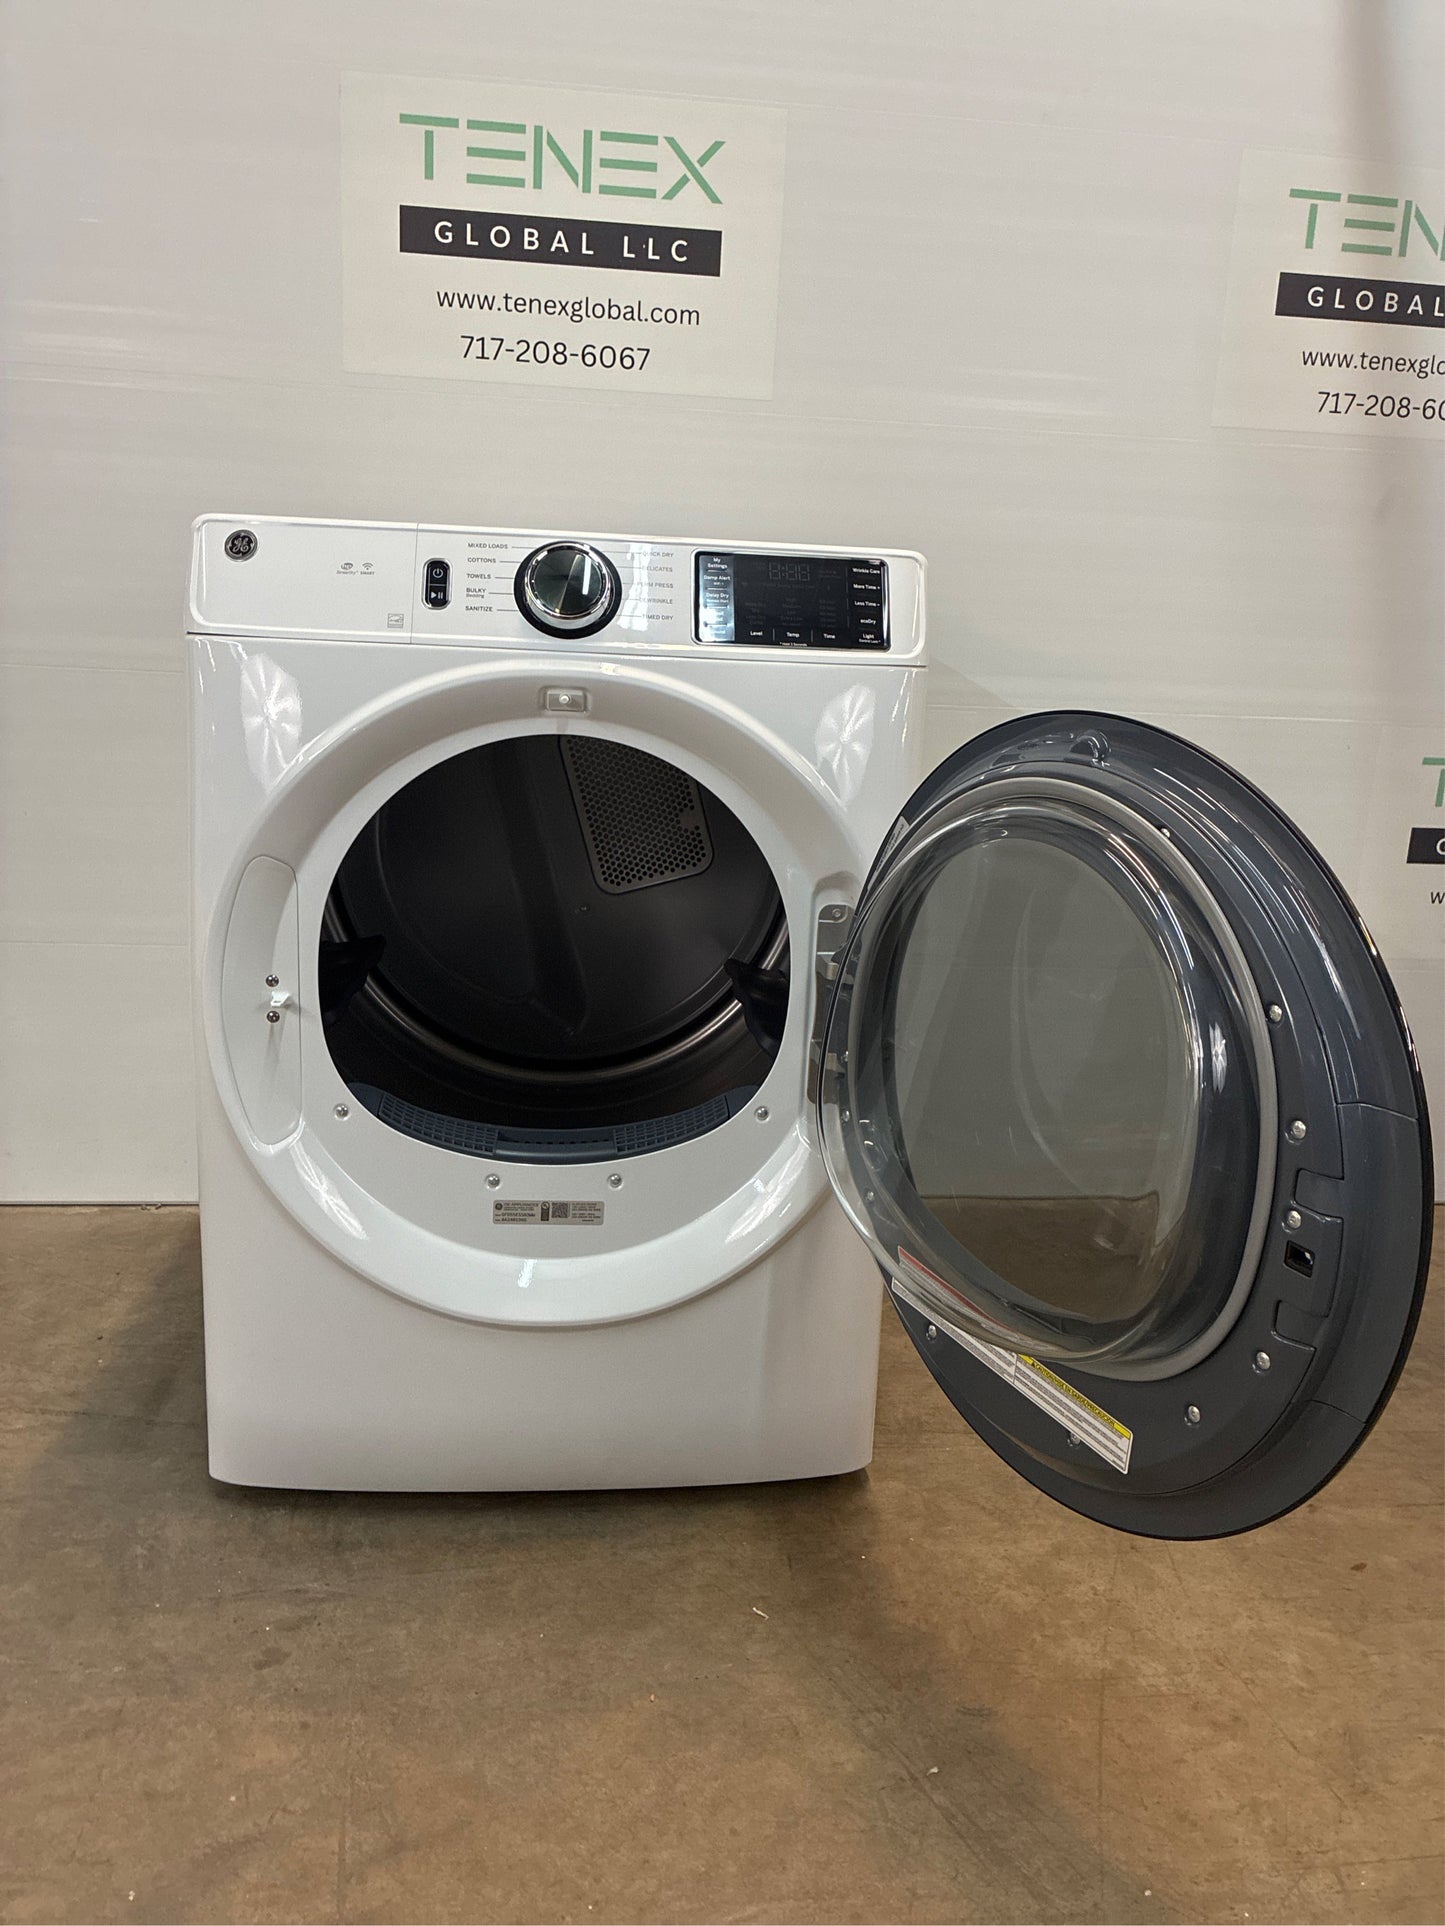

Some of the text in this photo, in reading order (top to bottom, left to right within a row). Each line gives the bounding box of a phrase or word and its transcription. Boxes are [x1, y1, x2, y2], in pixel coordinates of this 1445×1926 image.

[399, 113, 726, 204] TENEX
[433, 220, 690, 263] GLOBAL LLC
[436, 289, 701, 327] www.tenexglobal.com
[1307, 286, 1445, 317] GLOBAL
[460, 335, 650, 371] 717-208-6067
[707, 562, 728, 570] Settings
[862, 632, 875, 640] Light
